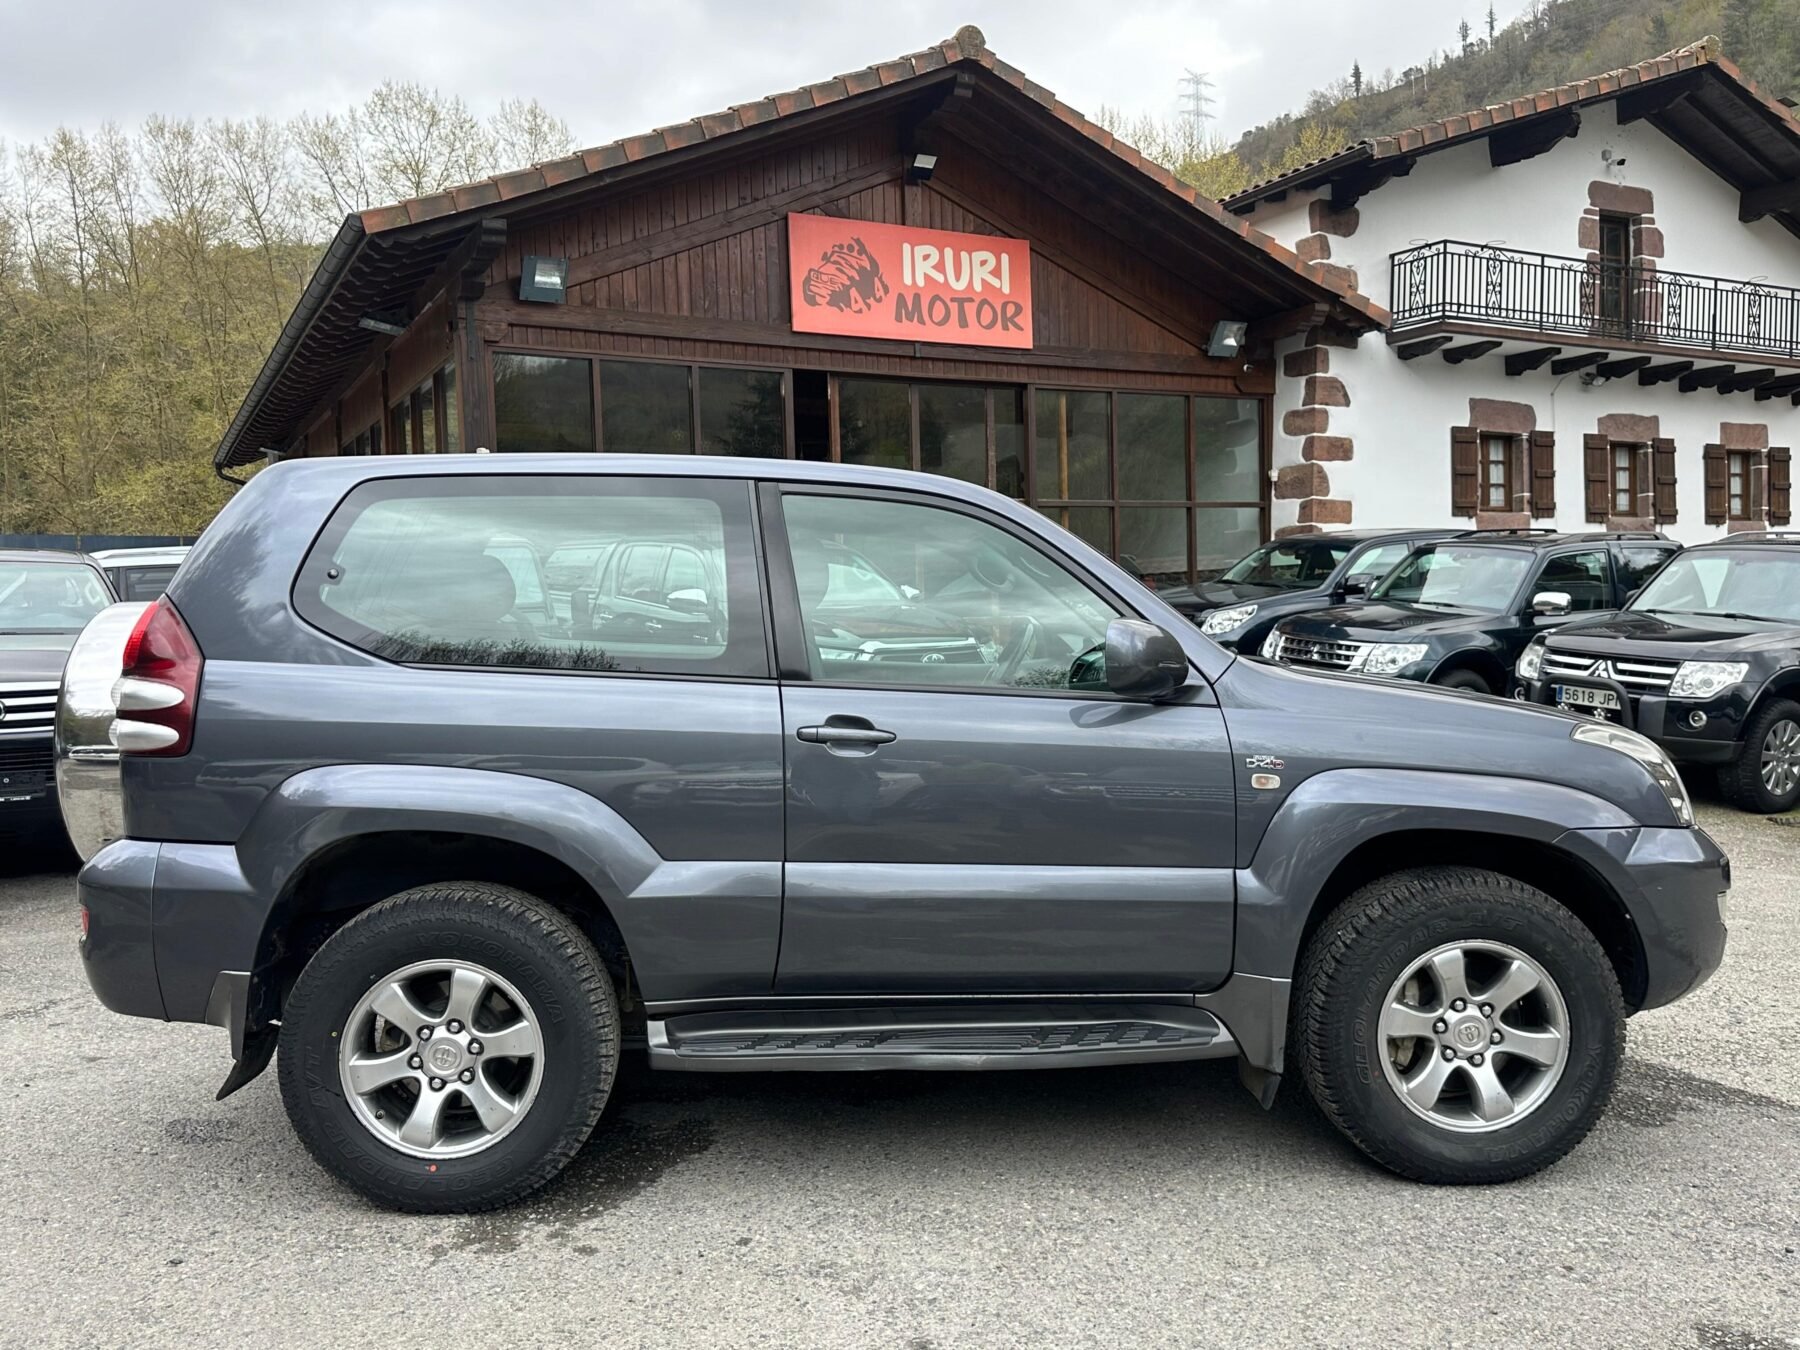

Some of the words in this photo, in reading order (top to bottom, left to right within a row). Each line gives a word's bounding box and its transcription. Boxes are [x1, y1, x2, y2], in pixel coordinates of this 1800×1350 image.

[902, 242, 1010, 294] IRURI
[894, 292, 1024, 331] MOTOR
[1564, 688, 1595, 703] 5618
[416, 931, 565, 1025] YOKOHAMA
[1353, 918, 1449, 1085] GEOLANDAR
[1483, 1045, 1602, 1162] YOKOHAMA
[318, 1117, 513, 1192] GEOLANDAR
